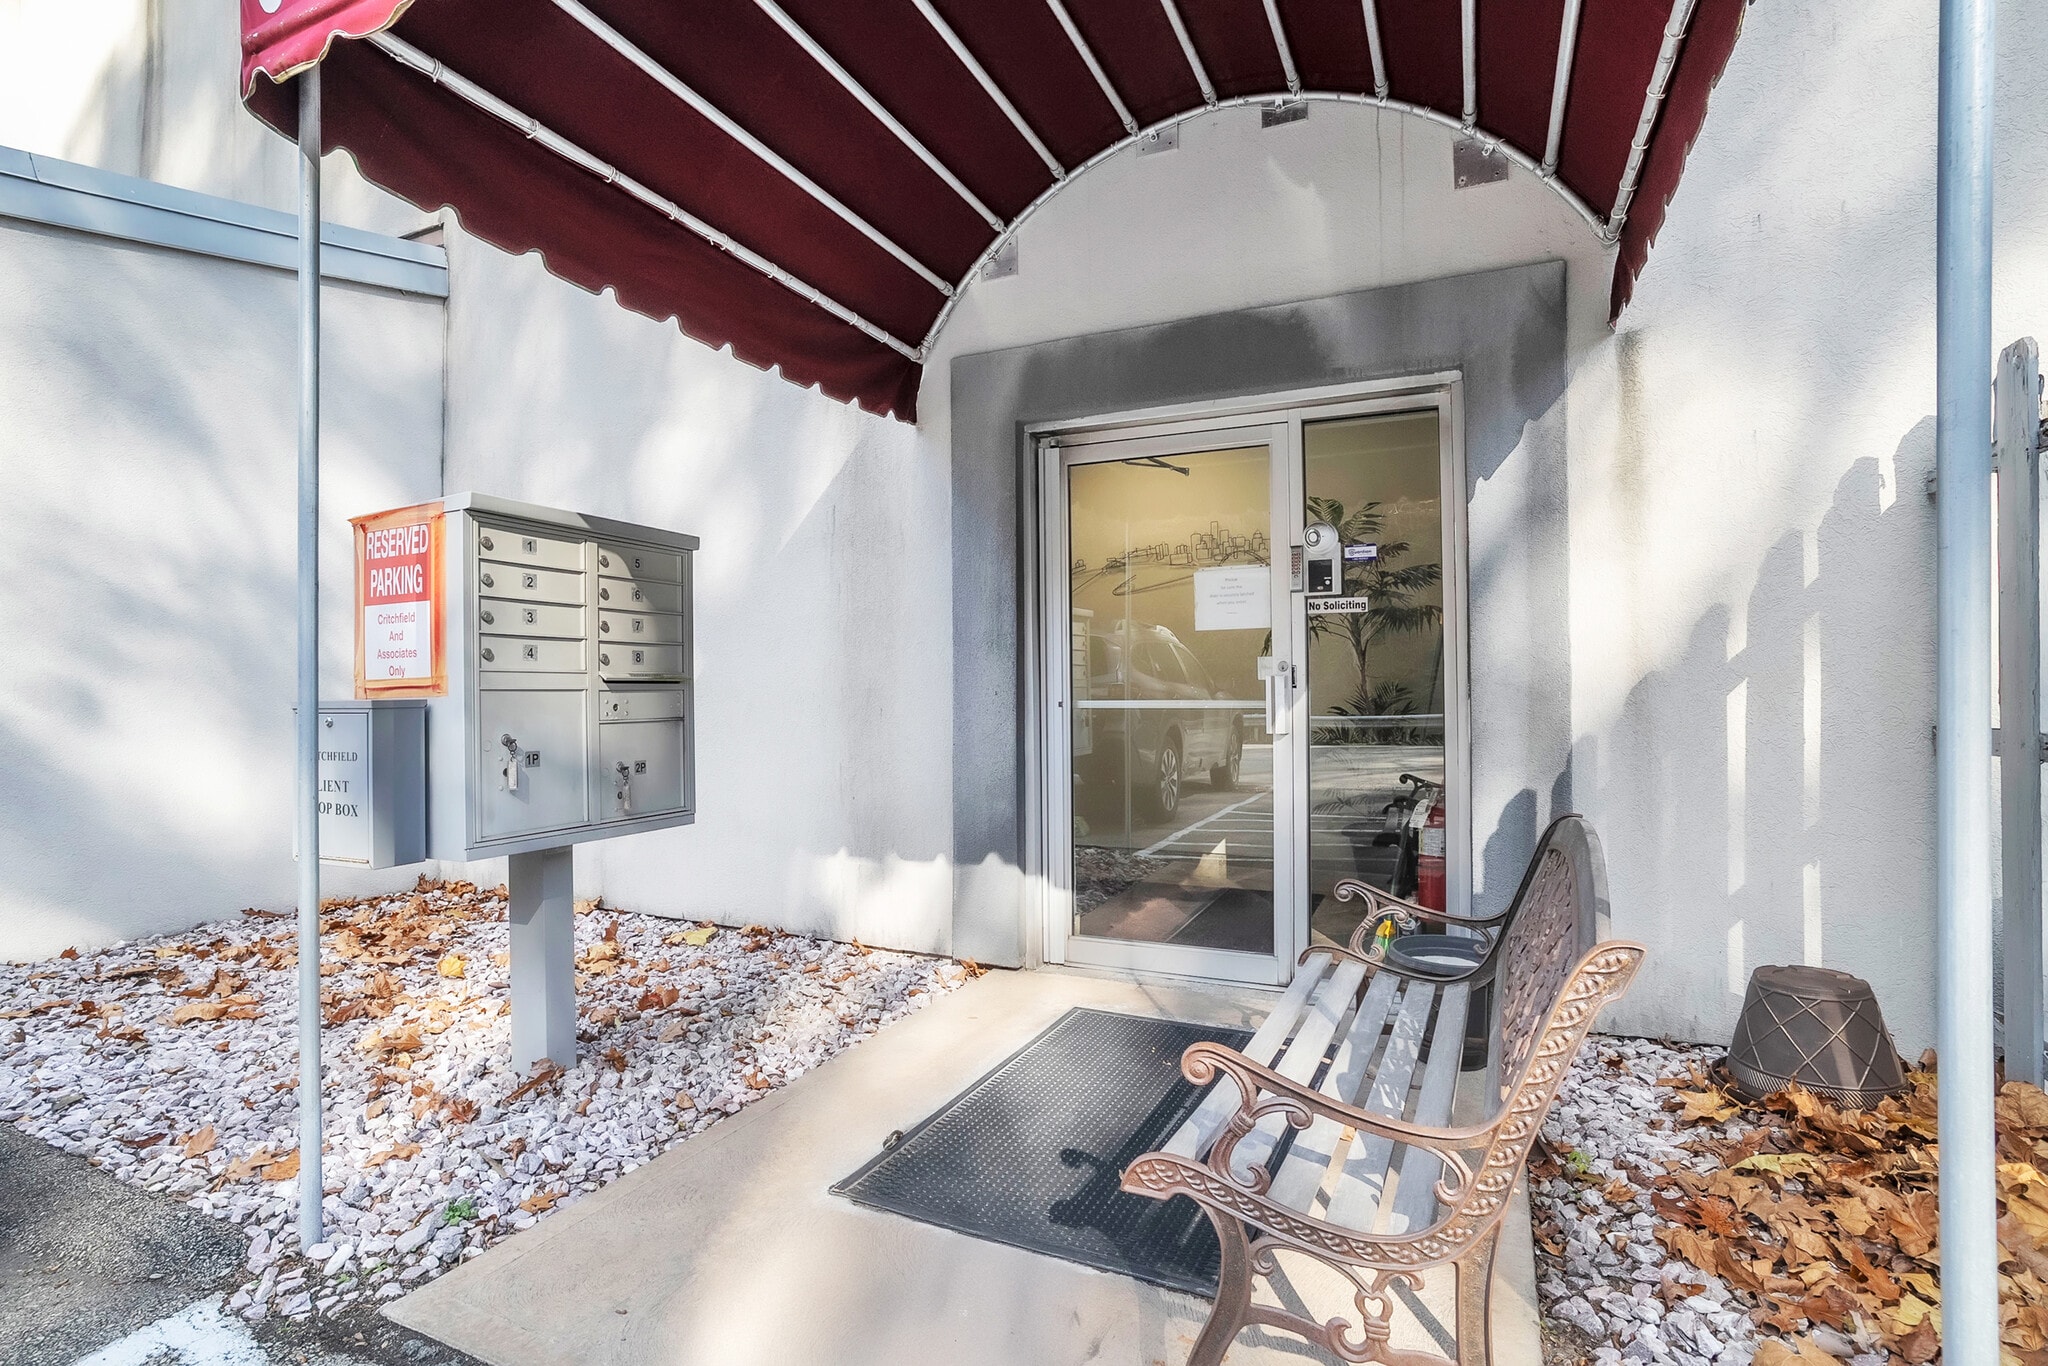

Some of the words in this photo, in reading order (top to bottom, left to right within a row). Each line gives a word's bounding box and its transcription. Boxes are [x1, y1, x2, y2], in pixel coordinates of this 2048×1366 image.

[366, 524, 429, 560] RESERVED
[526, 541, 533, 552] 1
[634, 558, 641, 569] 5
[370, 563, 423, 598] PARKING
[526, 576, 534, 588] 2
[634, 589, 641, 600] 6
[1308, 601, 1321, 611] No
[1323, 600, 1367, 611] Soliciting
[377, 611, 416, 625] Critchfield
[526, 611, 534, 623] 3
[634, 620, 641, 631] 7
[388, 630, 404, 641] And
[376, 648, 418, 660] Associates
[526, 647, 534, 659] 4
[634, 652, 642, 663] 8
[388, 665, 406, 679] Only
[318, 751, 358, 762] TCHFIELD
[526, 753, 540, 766] 1P
[635, 762, 647, 774] 2P
[318, 779, 350, 793] IENT
[318, 801, 333, 815] OP
[335, 803, 359, 818] BOX
